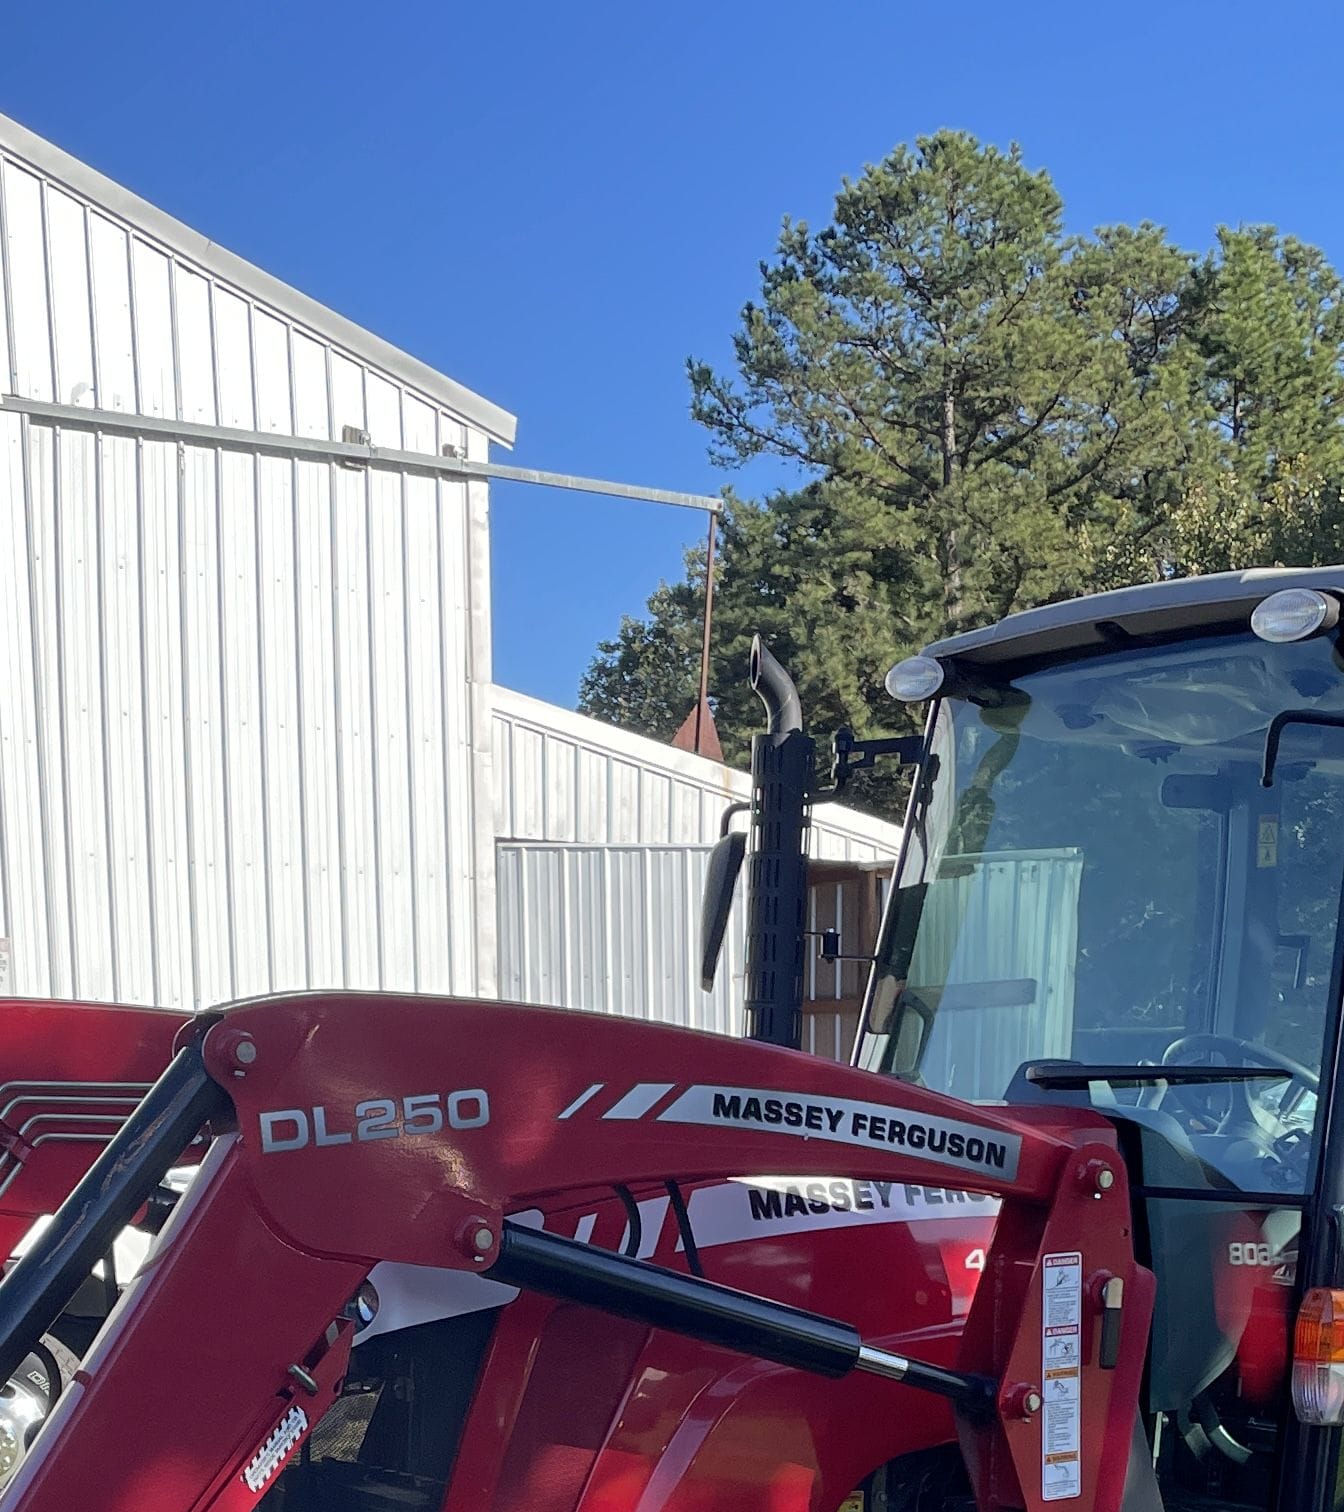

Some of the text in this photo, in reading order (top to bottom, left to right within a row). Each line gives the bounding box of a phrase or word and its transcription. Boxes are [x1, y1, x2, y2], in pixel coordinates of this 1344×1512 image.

[259, 1088, 490, 1153] DL250
[712, 1092, 1007, 1169] MASSEY FERGUSON
[748, 1180, 898, 1221] MASSEY
